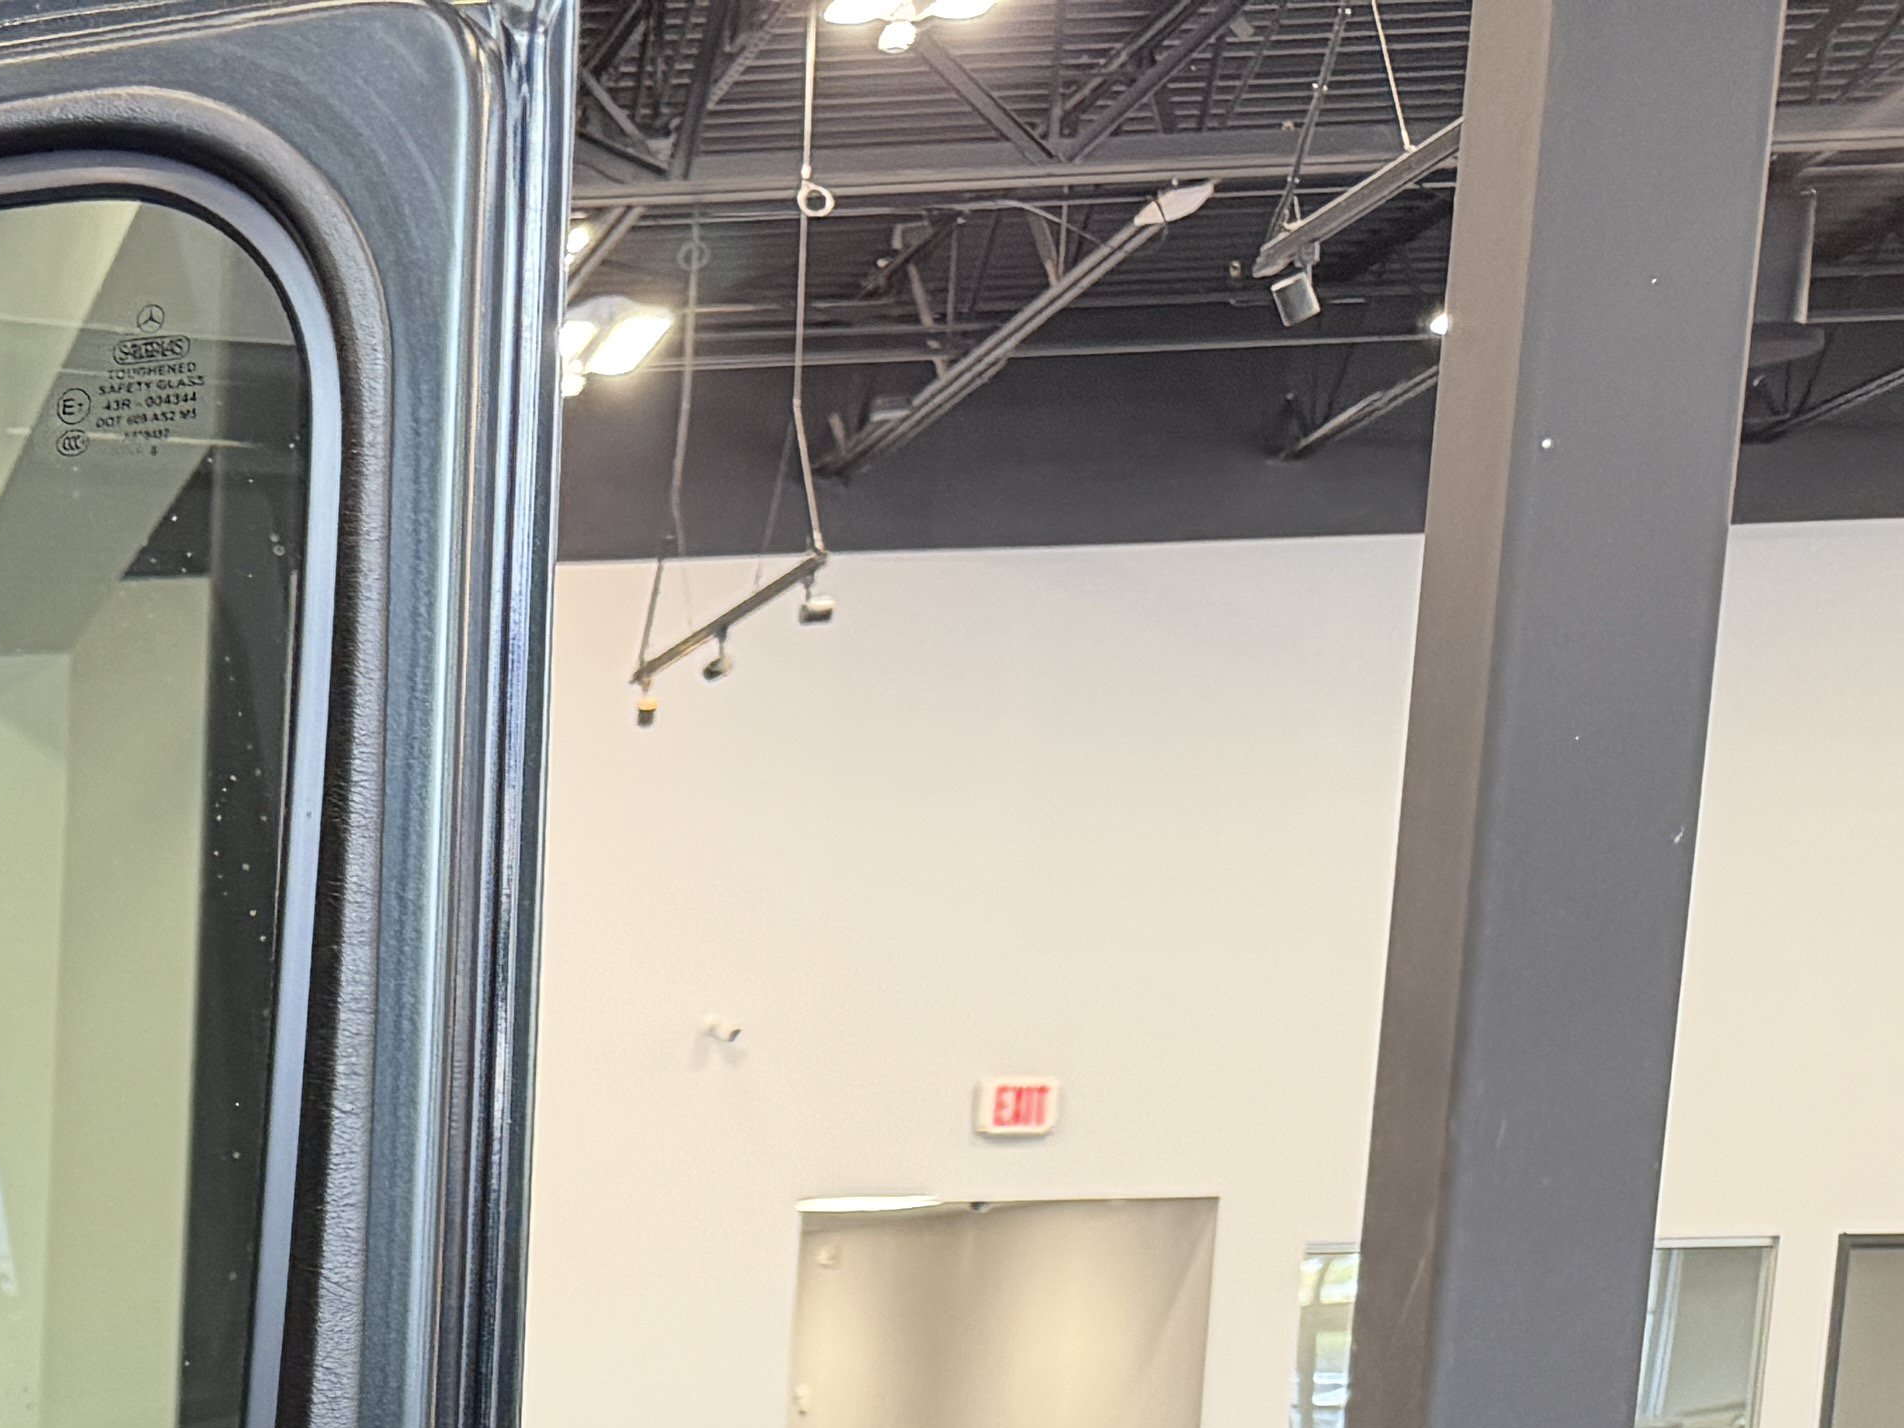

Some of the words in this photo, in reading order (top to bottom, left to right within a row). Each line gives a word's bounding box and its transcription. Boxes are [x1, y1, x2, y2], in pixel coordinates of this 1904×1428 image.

[107, 362, 197, 380] TOUGHENED
[98, 381, 153, 395] SAFETY
[156, 375, 205, 390] GLASS
[993, 1085, 1050, 1126] EXIT
